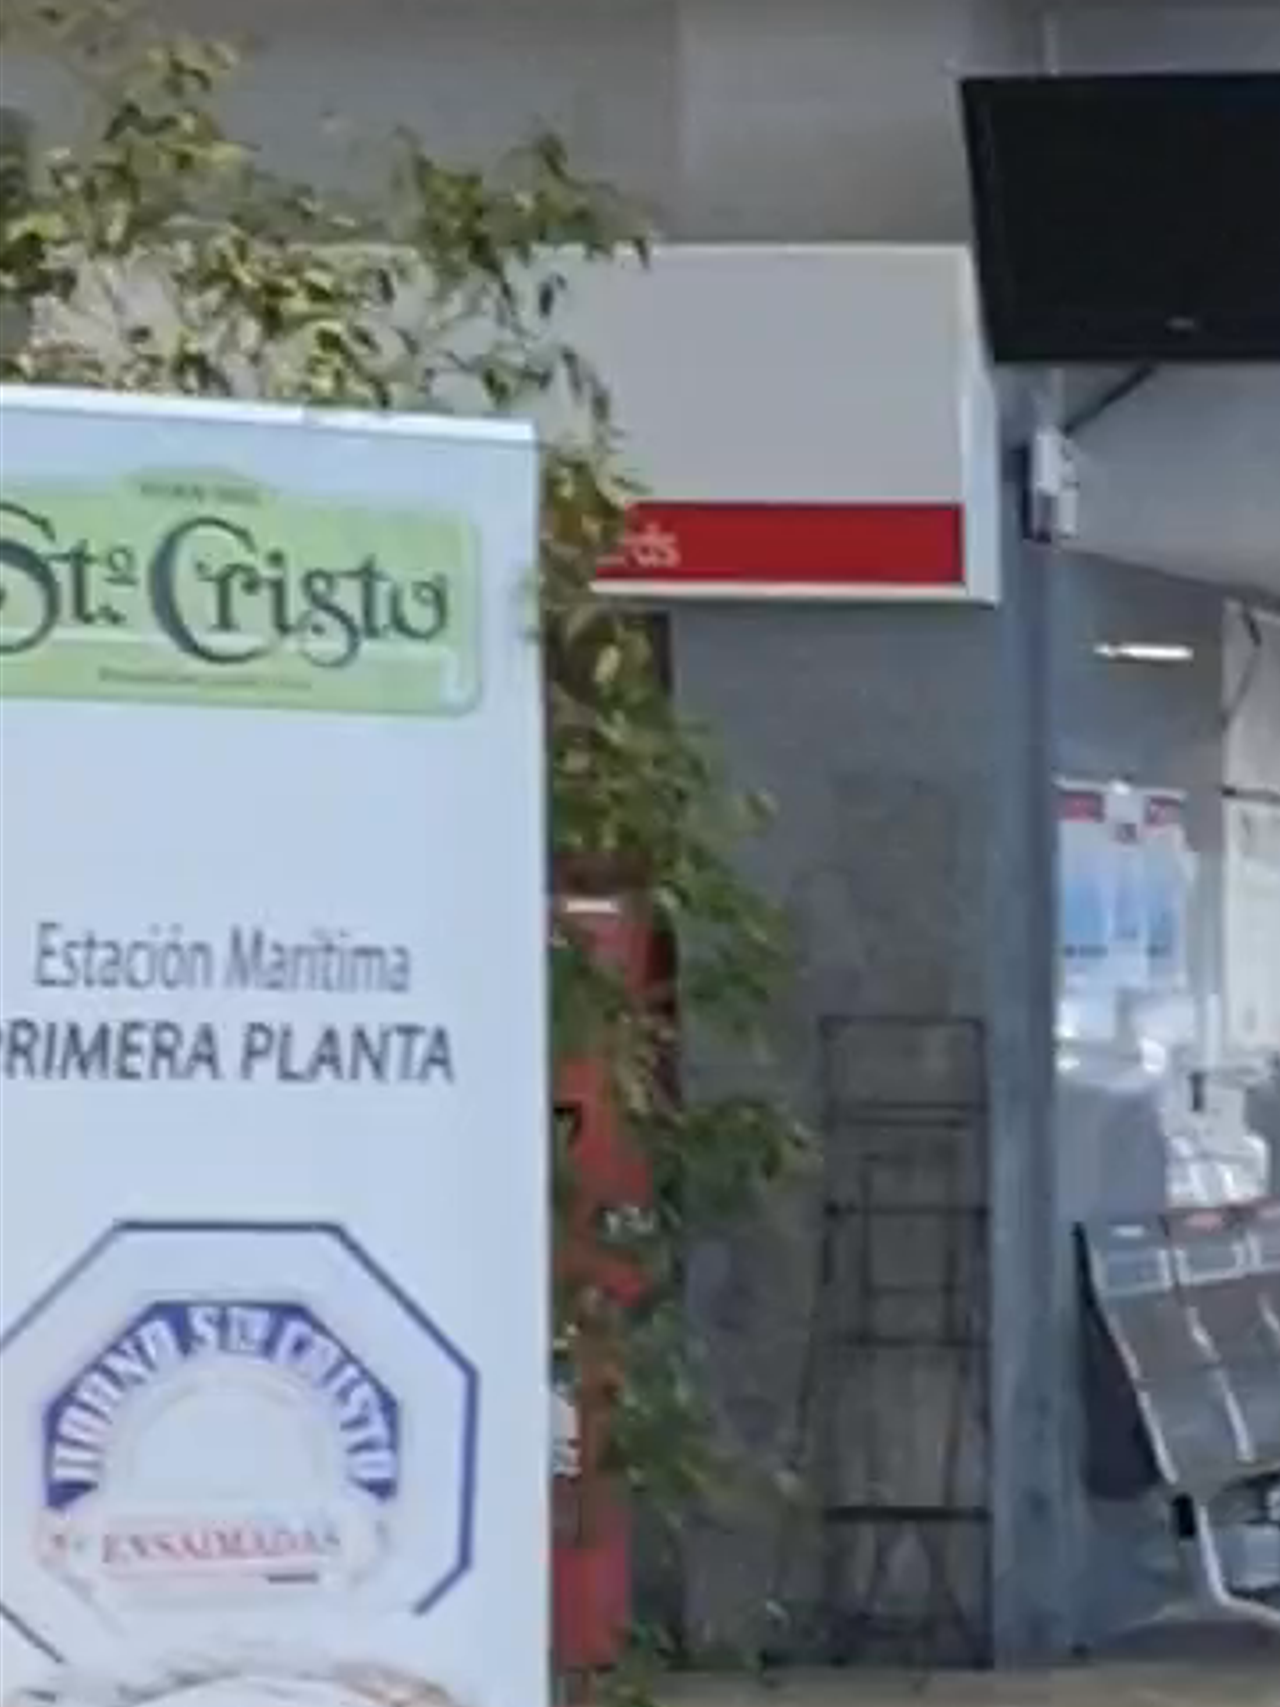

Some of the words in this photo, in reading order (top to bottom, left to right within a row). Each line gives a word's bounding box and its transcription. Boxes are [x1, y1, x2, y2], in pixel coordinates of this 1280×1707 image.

[148, 516, 449, 669] Cristo
[35, 921, 214, 990] Estación
[0, 1018, 222, 1081] RIMERA
[240, 1021, 455, 1082] PLANTA
